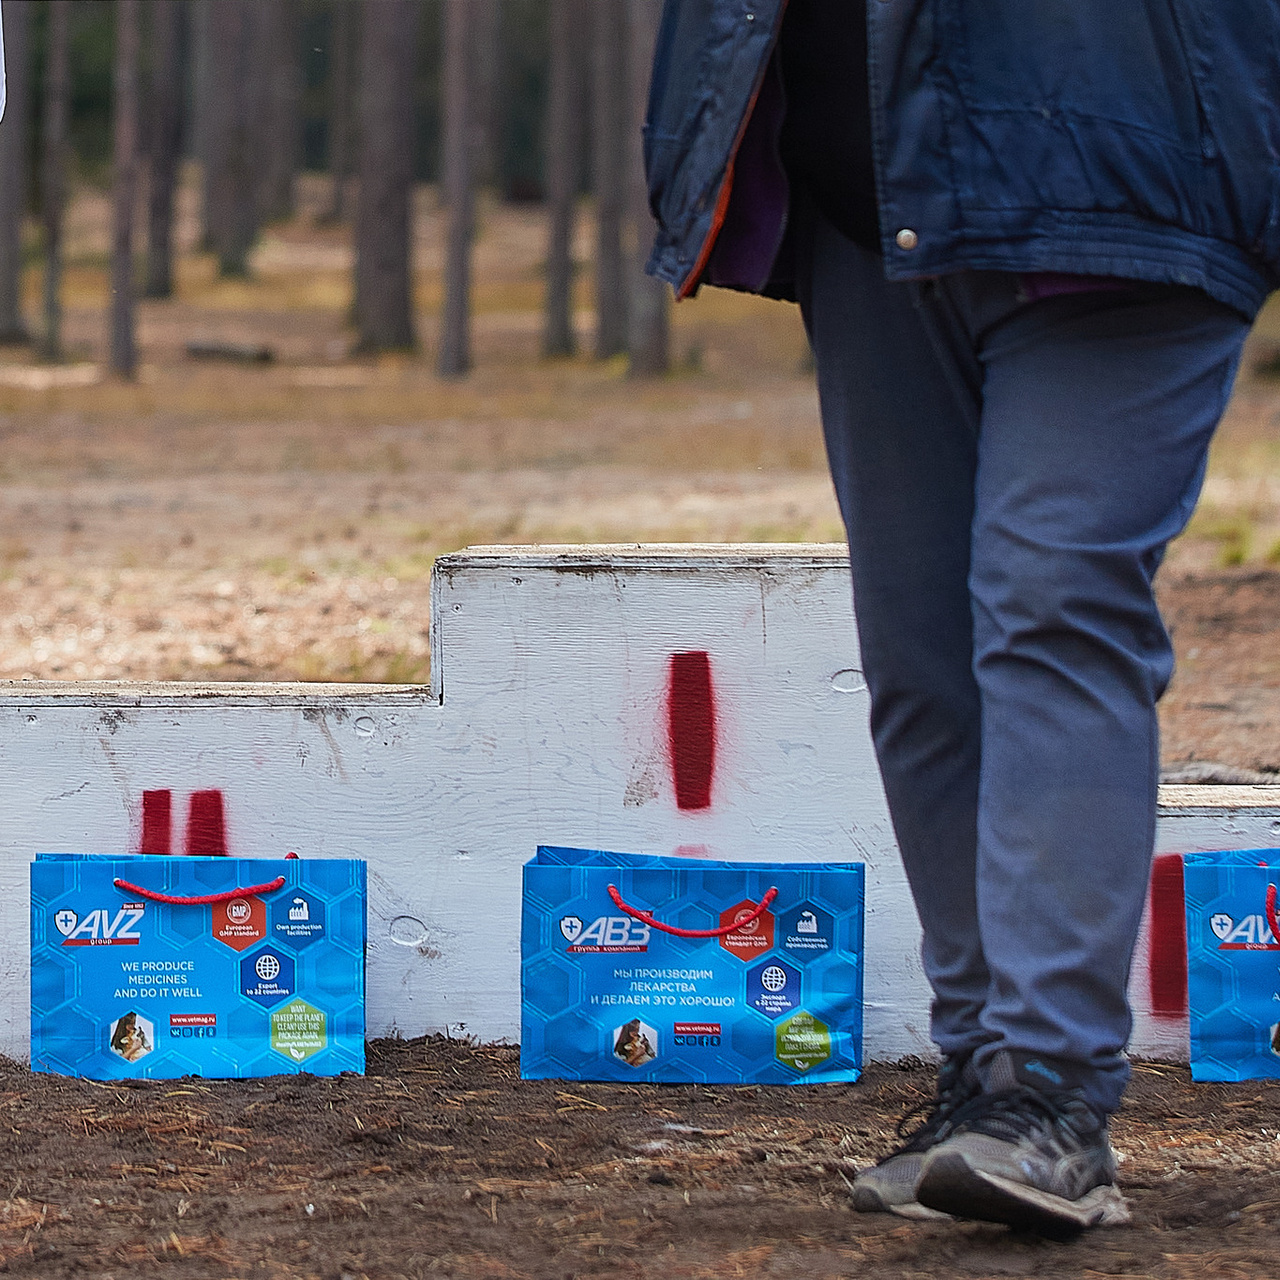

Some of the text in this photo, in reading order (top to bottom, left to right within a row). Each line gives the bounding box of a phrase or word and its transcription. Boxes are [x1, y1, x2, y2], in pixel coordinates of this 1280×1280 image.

[68, 910, 144, 939] AVZ
[1224, 914, 1280, 944] AV
[572, 917, 651, 946] АВЗ
[121, 960, 194, 971] WE PRODUCE
[129, 974, 187, 984] MEDICINES
[614, 969, 713, 980] МЫ ПРОИЗВОДИМ
[114, 987, 202, 998] AND DO IT WELL
[629, 982, 696, 992] ЛЕКАРСТВА
[591, 995, 736, 1007] И ДЕЛАЕМ ЭТО ХОРОШО!
